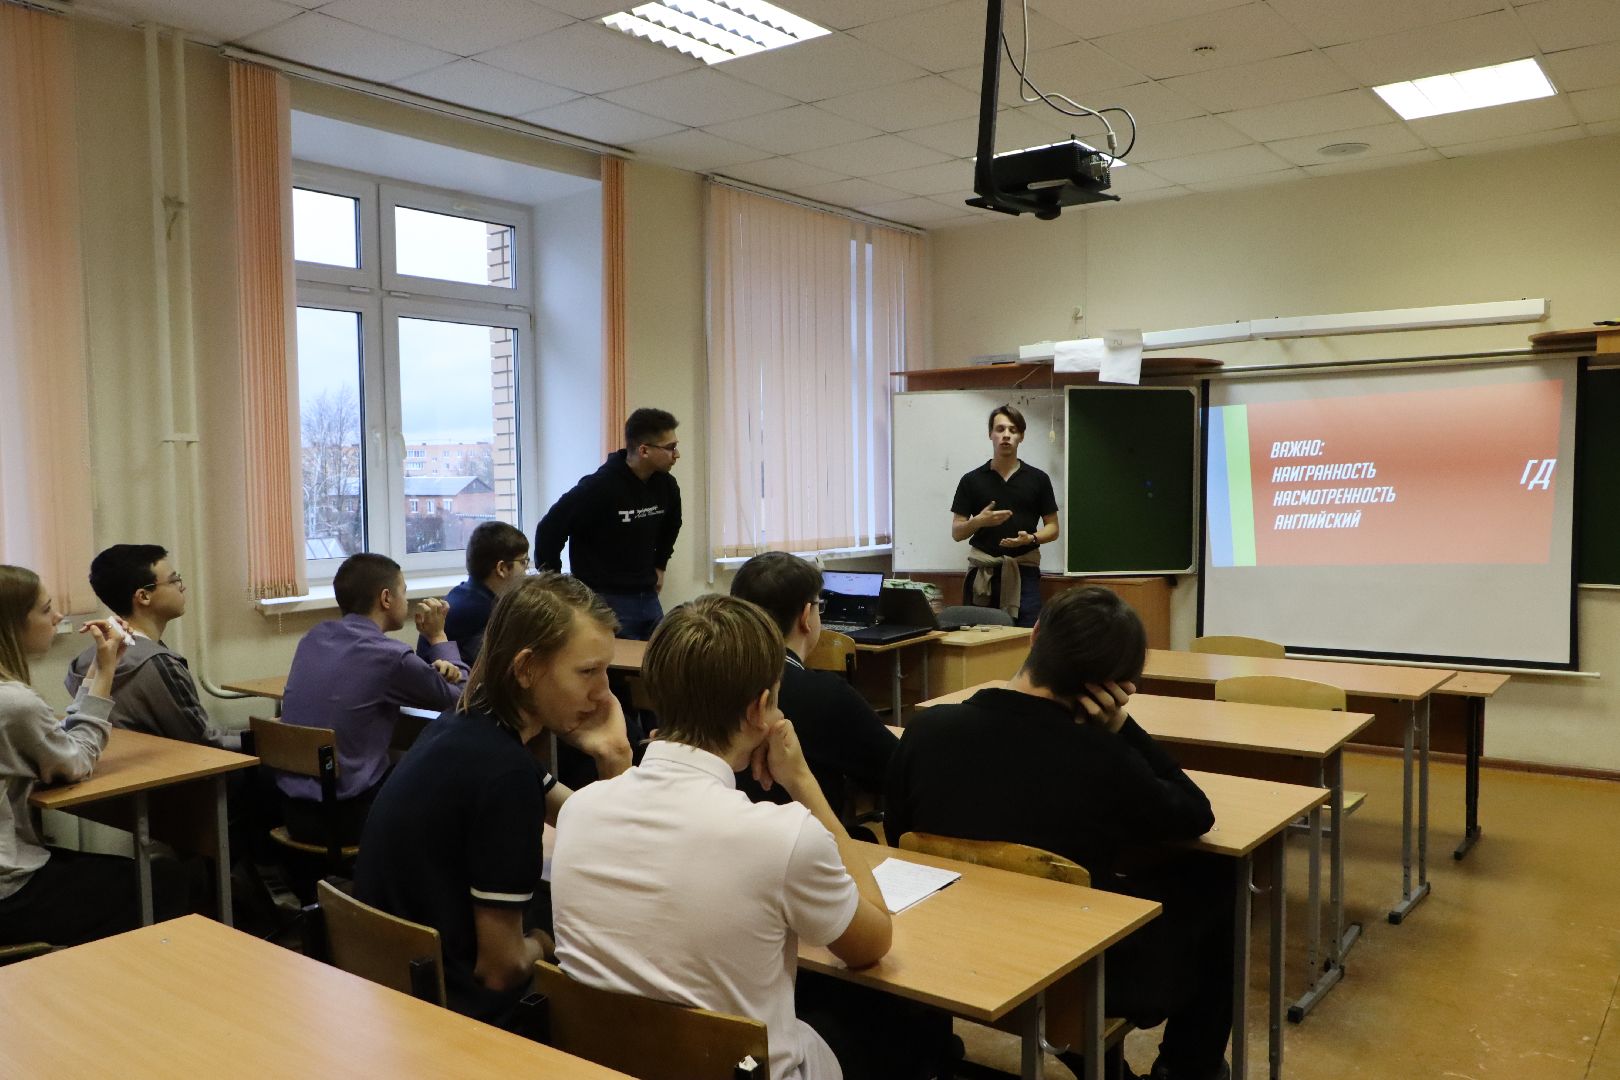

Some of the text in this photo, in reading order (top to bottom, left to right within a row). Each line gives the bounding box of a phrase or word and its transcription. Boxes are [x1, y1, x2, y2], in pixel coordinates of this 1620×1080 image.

[1270, 440, 1325, 458] ВАЖНО:
[1271, 462, 1377, 482] НАИГРАННОСТЬ
[1519, 458, 1557, 490] ГД
[1273, 486, 1396, 507] НАСМОТРЕННОСТЬ
[1274, 510, 1362, 530] АНГЛИЙСКИЙ
